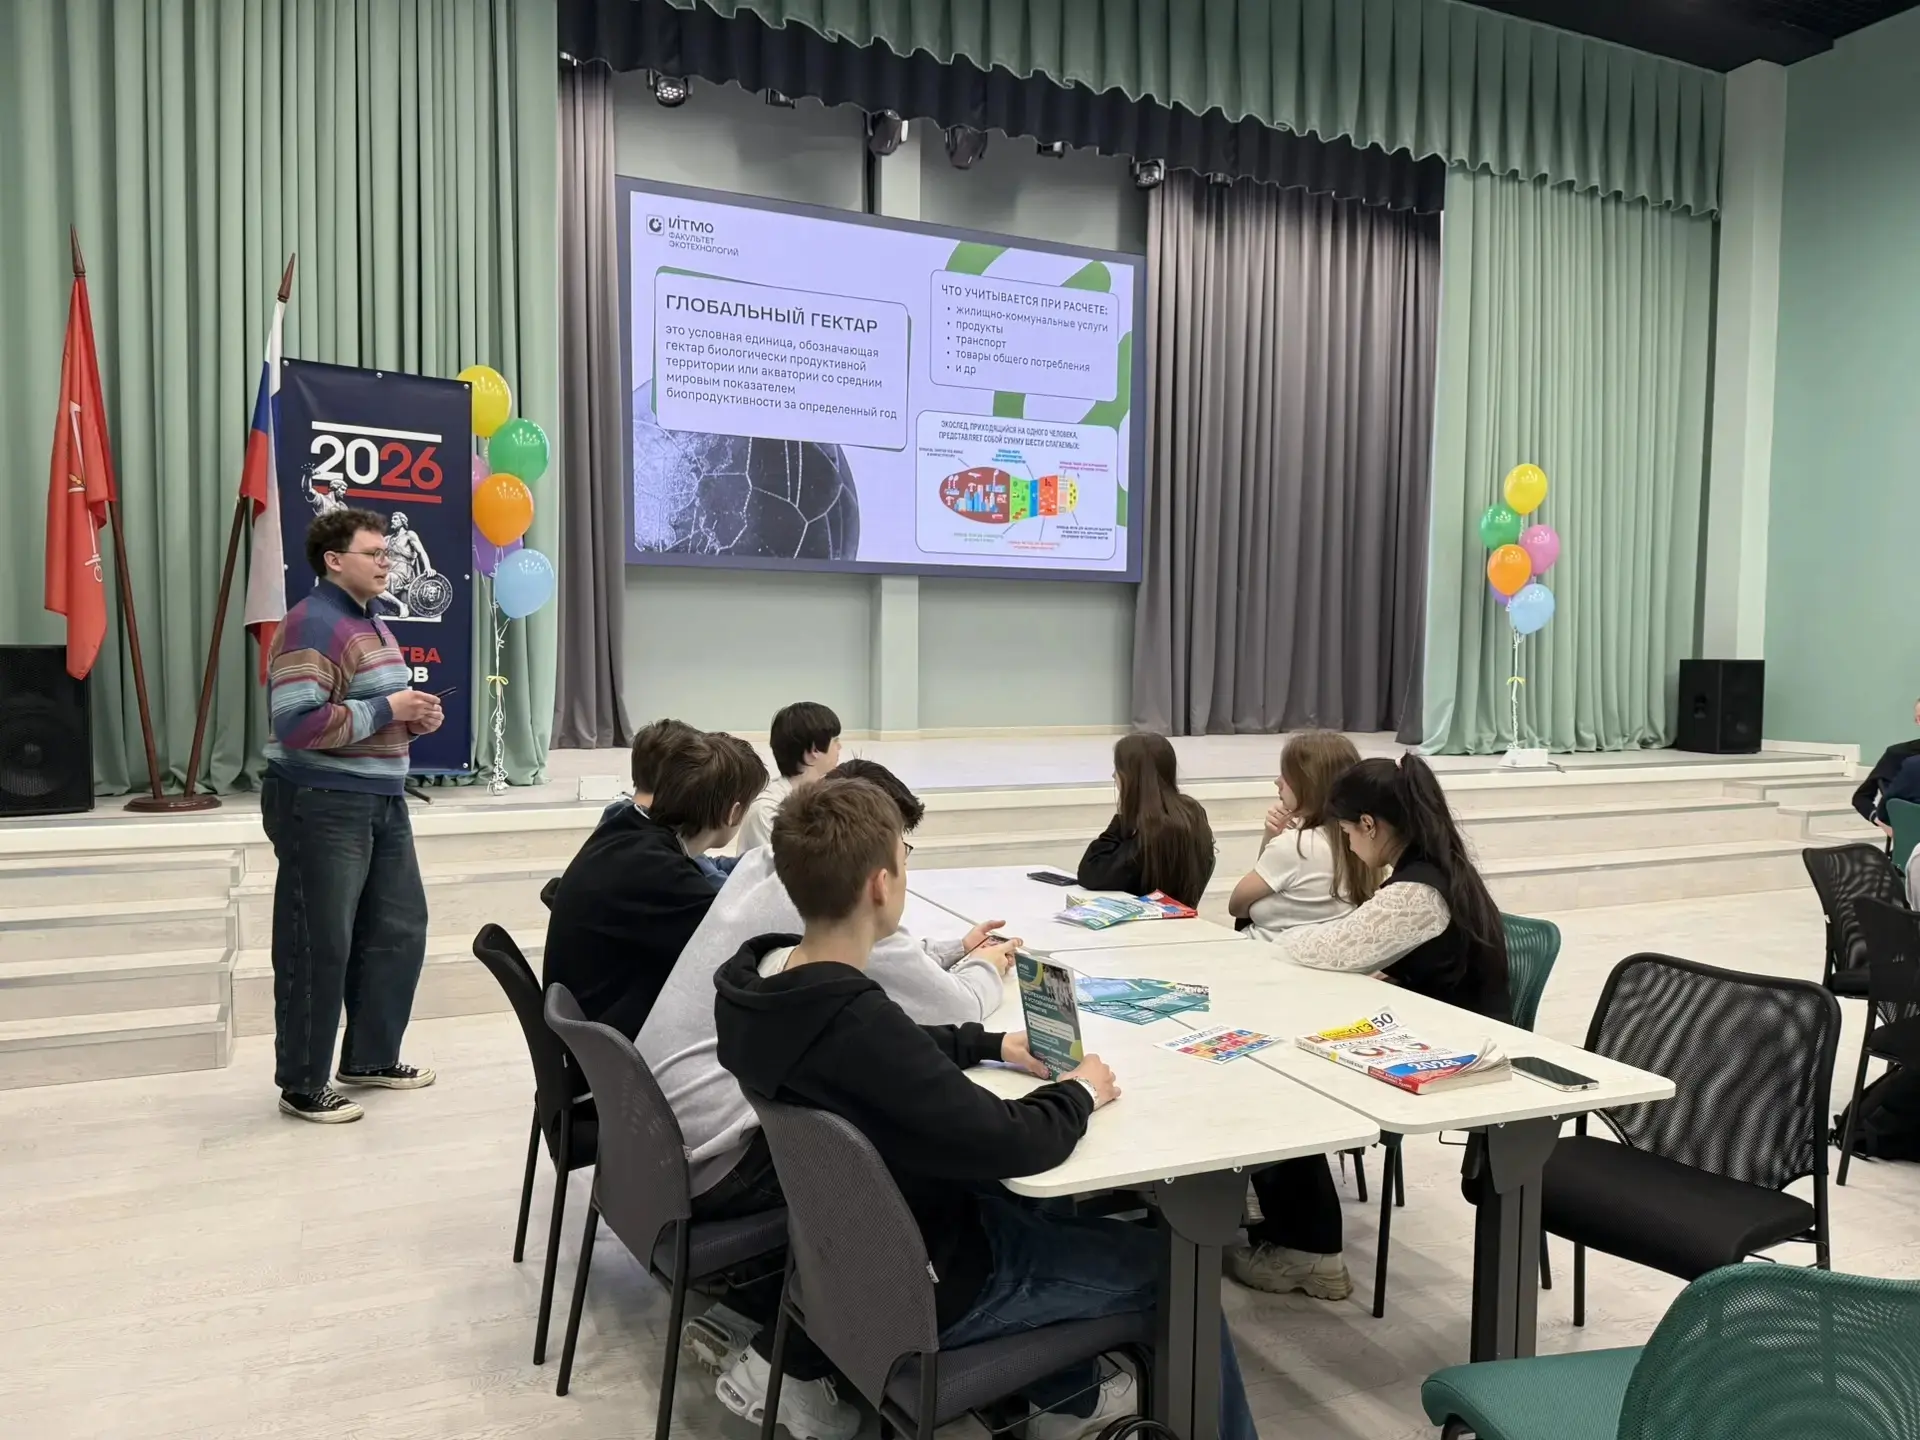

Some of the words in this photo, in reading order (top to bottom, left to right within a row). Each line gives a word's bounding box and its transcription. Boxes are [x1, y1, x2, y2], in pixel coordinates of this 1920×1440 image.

[668, 232, 714, 245] ФАКУЛЬТЕТ
[669, 240, 739, 257] ЭКОТЕХНОЛОГИЙ
[941, 285, 962, 296] ЧТО
[965, 288, 1038, 306] УЧИТЫВАЕТСЯ
[1041, 297, 1061, 309] ПРИ
[1063, 300, 1108, 315] РАСЧЕТЕ:
[666, 294, 805, 325] ГЛОБАЛЬНЫЙ
[811, 313, 877, 333] ГЕКТАР
[956, 305, 1075, 328] жилищно-коммунальные
[1077, 320, 1108, 332] услуги
[956, 320, 1003, 334] продукты
[665, 325, 685, 336] это
[688, 326, 742, 343] условная
[745, 334, 796, 350] единица,
[799, 339, 879, 358] обозначающая
[956, 335, 1006, 349] транспорт
[665, 343, 705, 356] гектар
[707, 344, 787, 363] биологически
[790, 355, 867, 371] продуктивной
[956, 349, 991, 363] товары
[993, 353, 1029, 365] общего
[1030, 358, 1090, 372] потребления
[666, 358, 735, 374] территории
[738, 365, 759, 375] или
[761, 368, 819, 383] акватории
[822, 374, 834, 382] со
[837, 376, 882, 389] средним
[955, 365, 962, 373] и
[964, 366, 976, 375] др
[666, 374, 720, 387] мировым
[723, 380, 795, 395] показателем
[666, 387, 781, 409] биопродуктивности
[784, 399, 796, 409] за
[799, 401, 877, 418] определенный
[880, 408, 897, 420] год
[938, 431, 982, 442] ПРЕДСТАВЛЯЕТ
[984, 435, 1002, 444] СОБОЙ
[1003, 437, 1024, 446] СУММУ
[1025, 438, 1045, 447] ШЕСТИ
[970, 422, 1016, 435] ПРИХОДЯЩИЙСЯ
[1018, 427, 1025, 435] НА
[1027, 427, 1048, 437] ОДНОГО
[310, 434, 443, 491] 2026
[1371, 1012, 1393, 1028] 50
